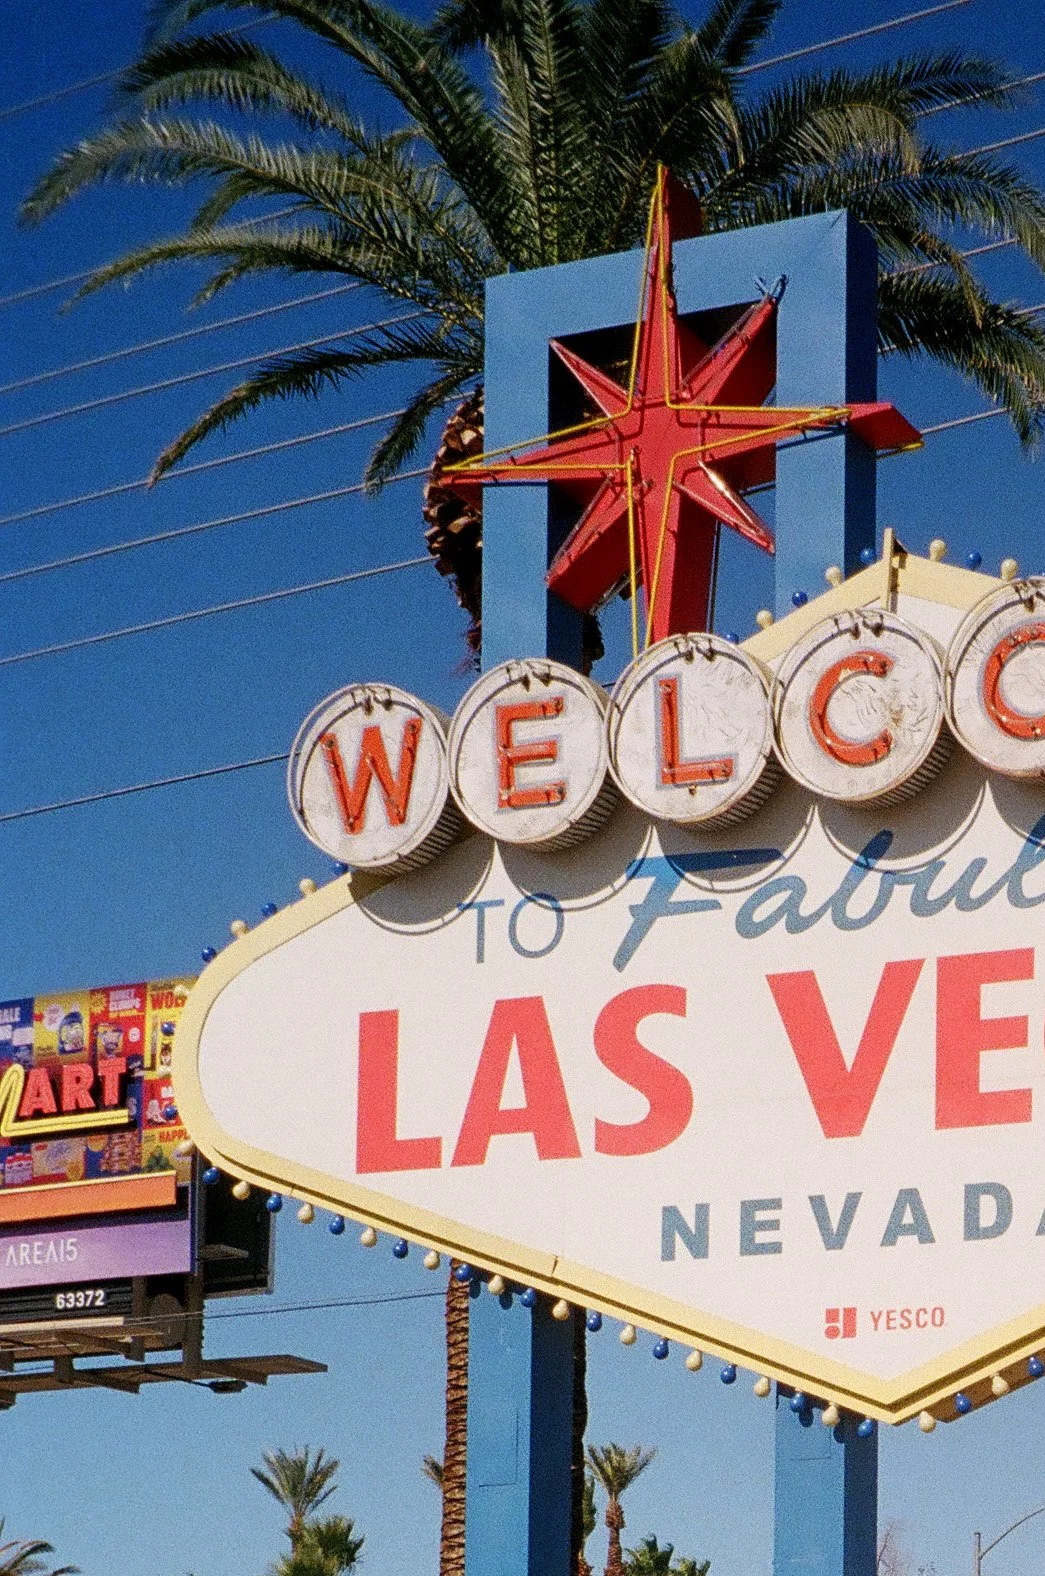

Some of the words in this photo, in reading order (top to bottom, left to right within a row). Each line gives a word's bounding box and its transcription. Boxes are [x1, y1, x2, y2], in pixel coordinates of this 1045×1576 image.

[457, 889, 564, 964] TO
[355, 983, 694, 1174] LAS
[6, 1237, 79, 1267] AREA15
[55, 1289, 105, 1310] 63372
[869, 1306, 946, 1333] YESCO
